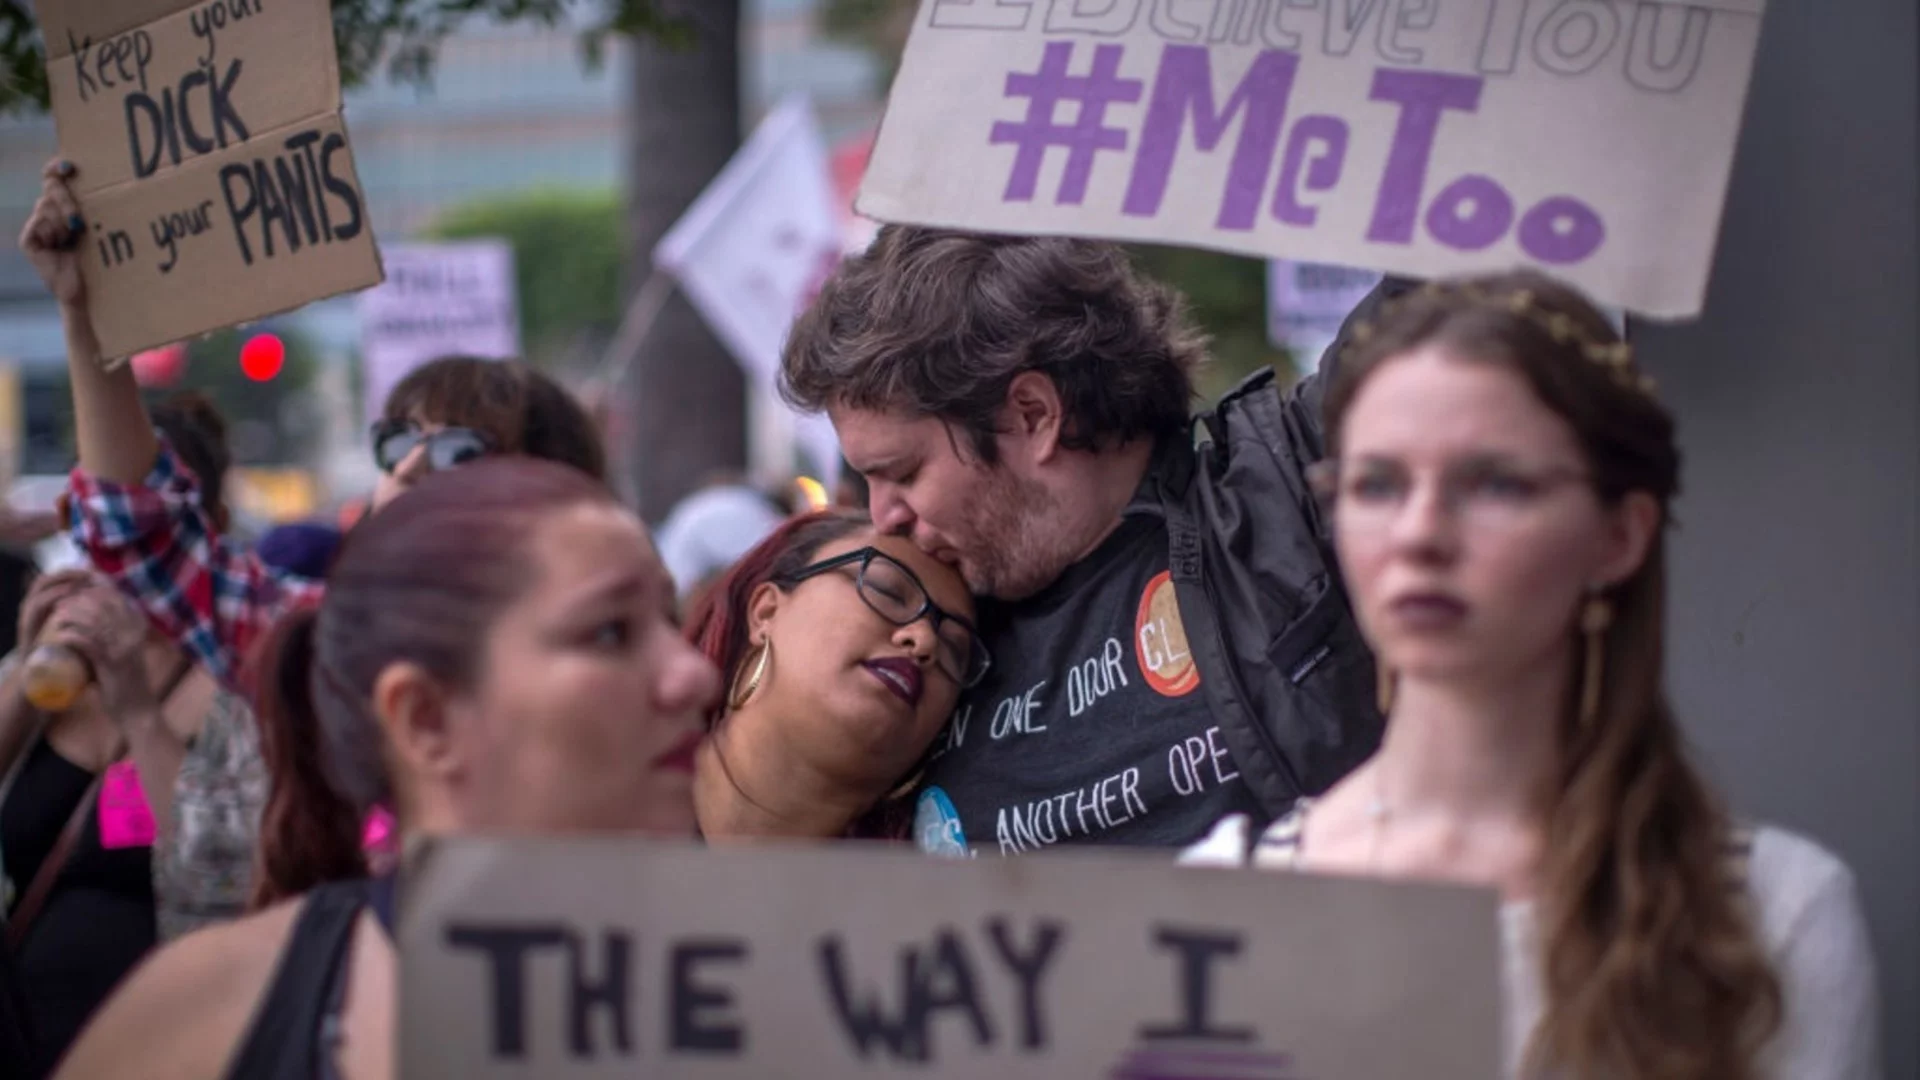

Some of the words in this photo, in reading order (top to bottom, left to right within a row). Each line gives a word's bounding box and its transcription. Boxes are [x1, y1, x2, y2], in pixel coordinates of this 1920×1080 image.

[124, 58, 249, 179] DICK
[96, 224, 133, 268] in
[151, 201, 214, 273] your
[219, 130, 363, 266] PANTS
[990, 681, 1047, 740] ONE
[997, 767, 1148, 857] ANOTHER
[1169, 726, 1239, 795] OPE
[444, 922, 748, 1059] THE
[817, 914, 1065, 1062] WAY
[1138, 921, 1256, 1042] I
